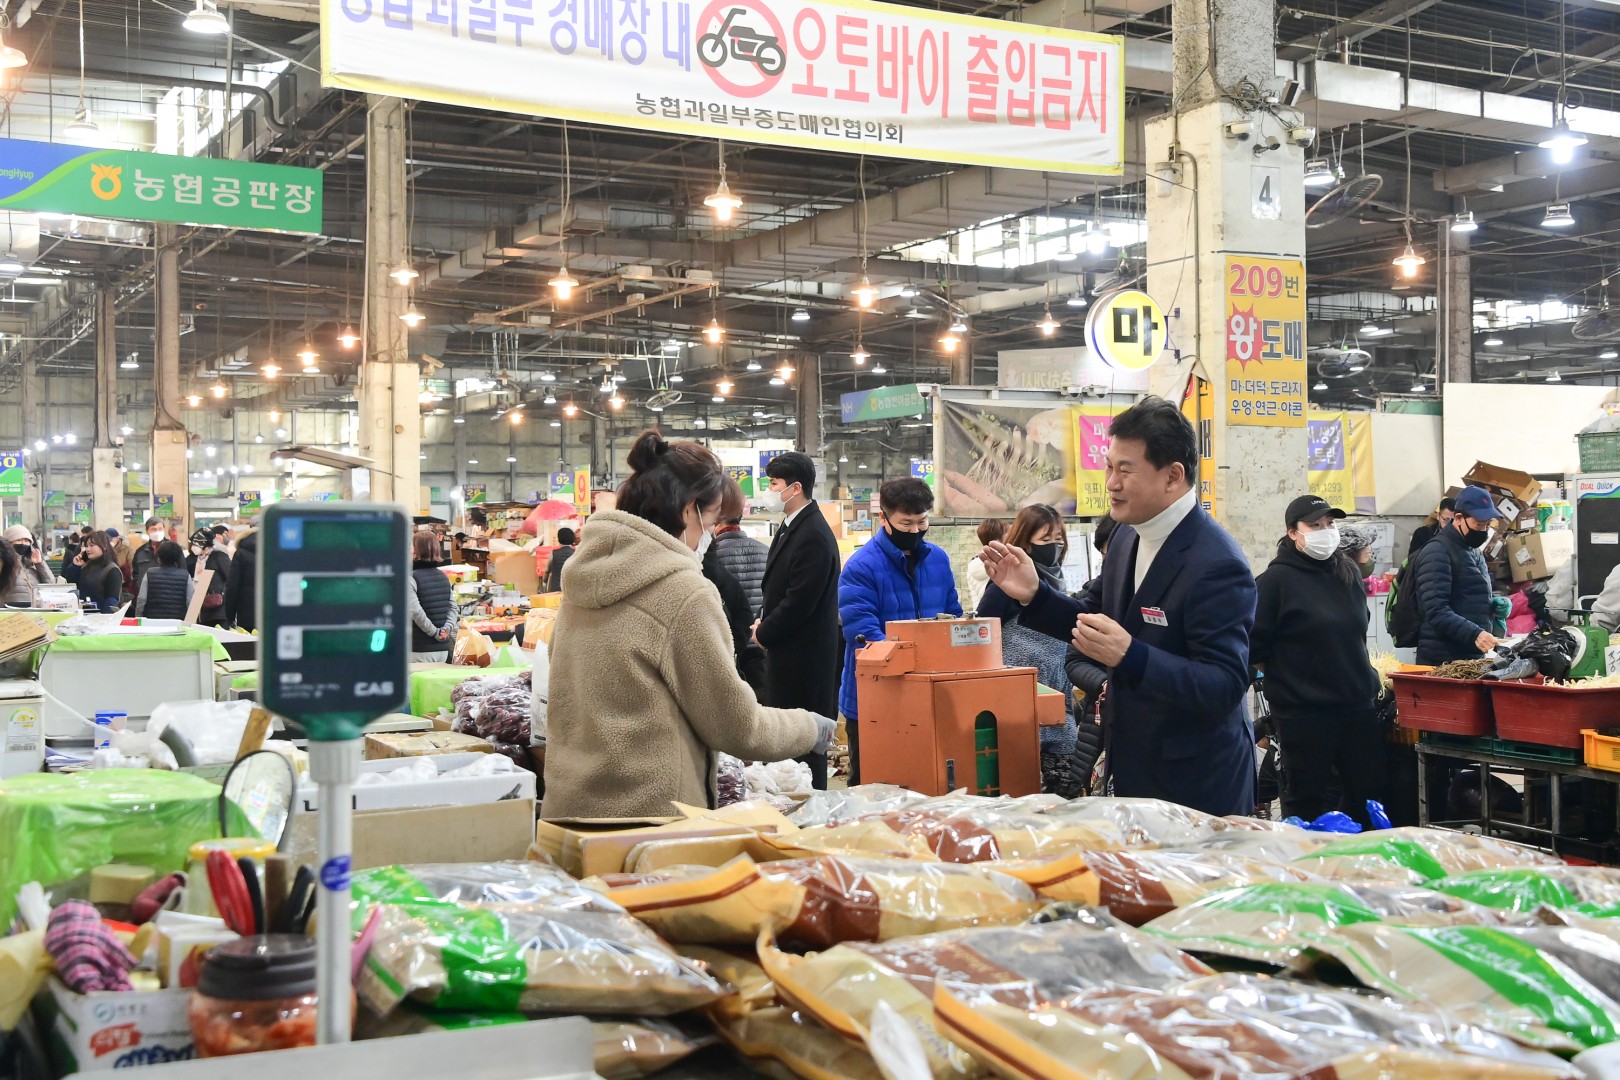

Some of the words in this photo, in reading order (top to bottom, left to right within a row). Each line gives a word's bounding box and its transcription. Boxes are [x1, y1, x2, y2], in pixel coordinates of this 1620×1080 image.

[549, 0, 648, 66] 경매장
[661, 1, 691, 73] 내
[791, 7, 949, 119] 오토바이
[965, 34, 1107, 134] 출입금지
[133, 168, 316, 214] 농협공판장
[1258, 175, 1273, 205] 4
[1229, 263, 1300, 299] 209번
[1113, 305, 1158, 356] 마
[1229, 314, 1303, 361] 왕도매
[556, 475, 570, 485] 92
[353, 681, 395, 697] CAS
